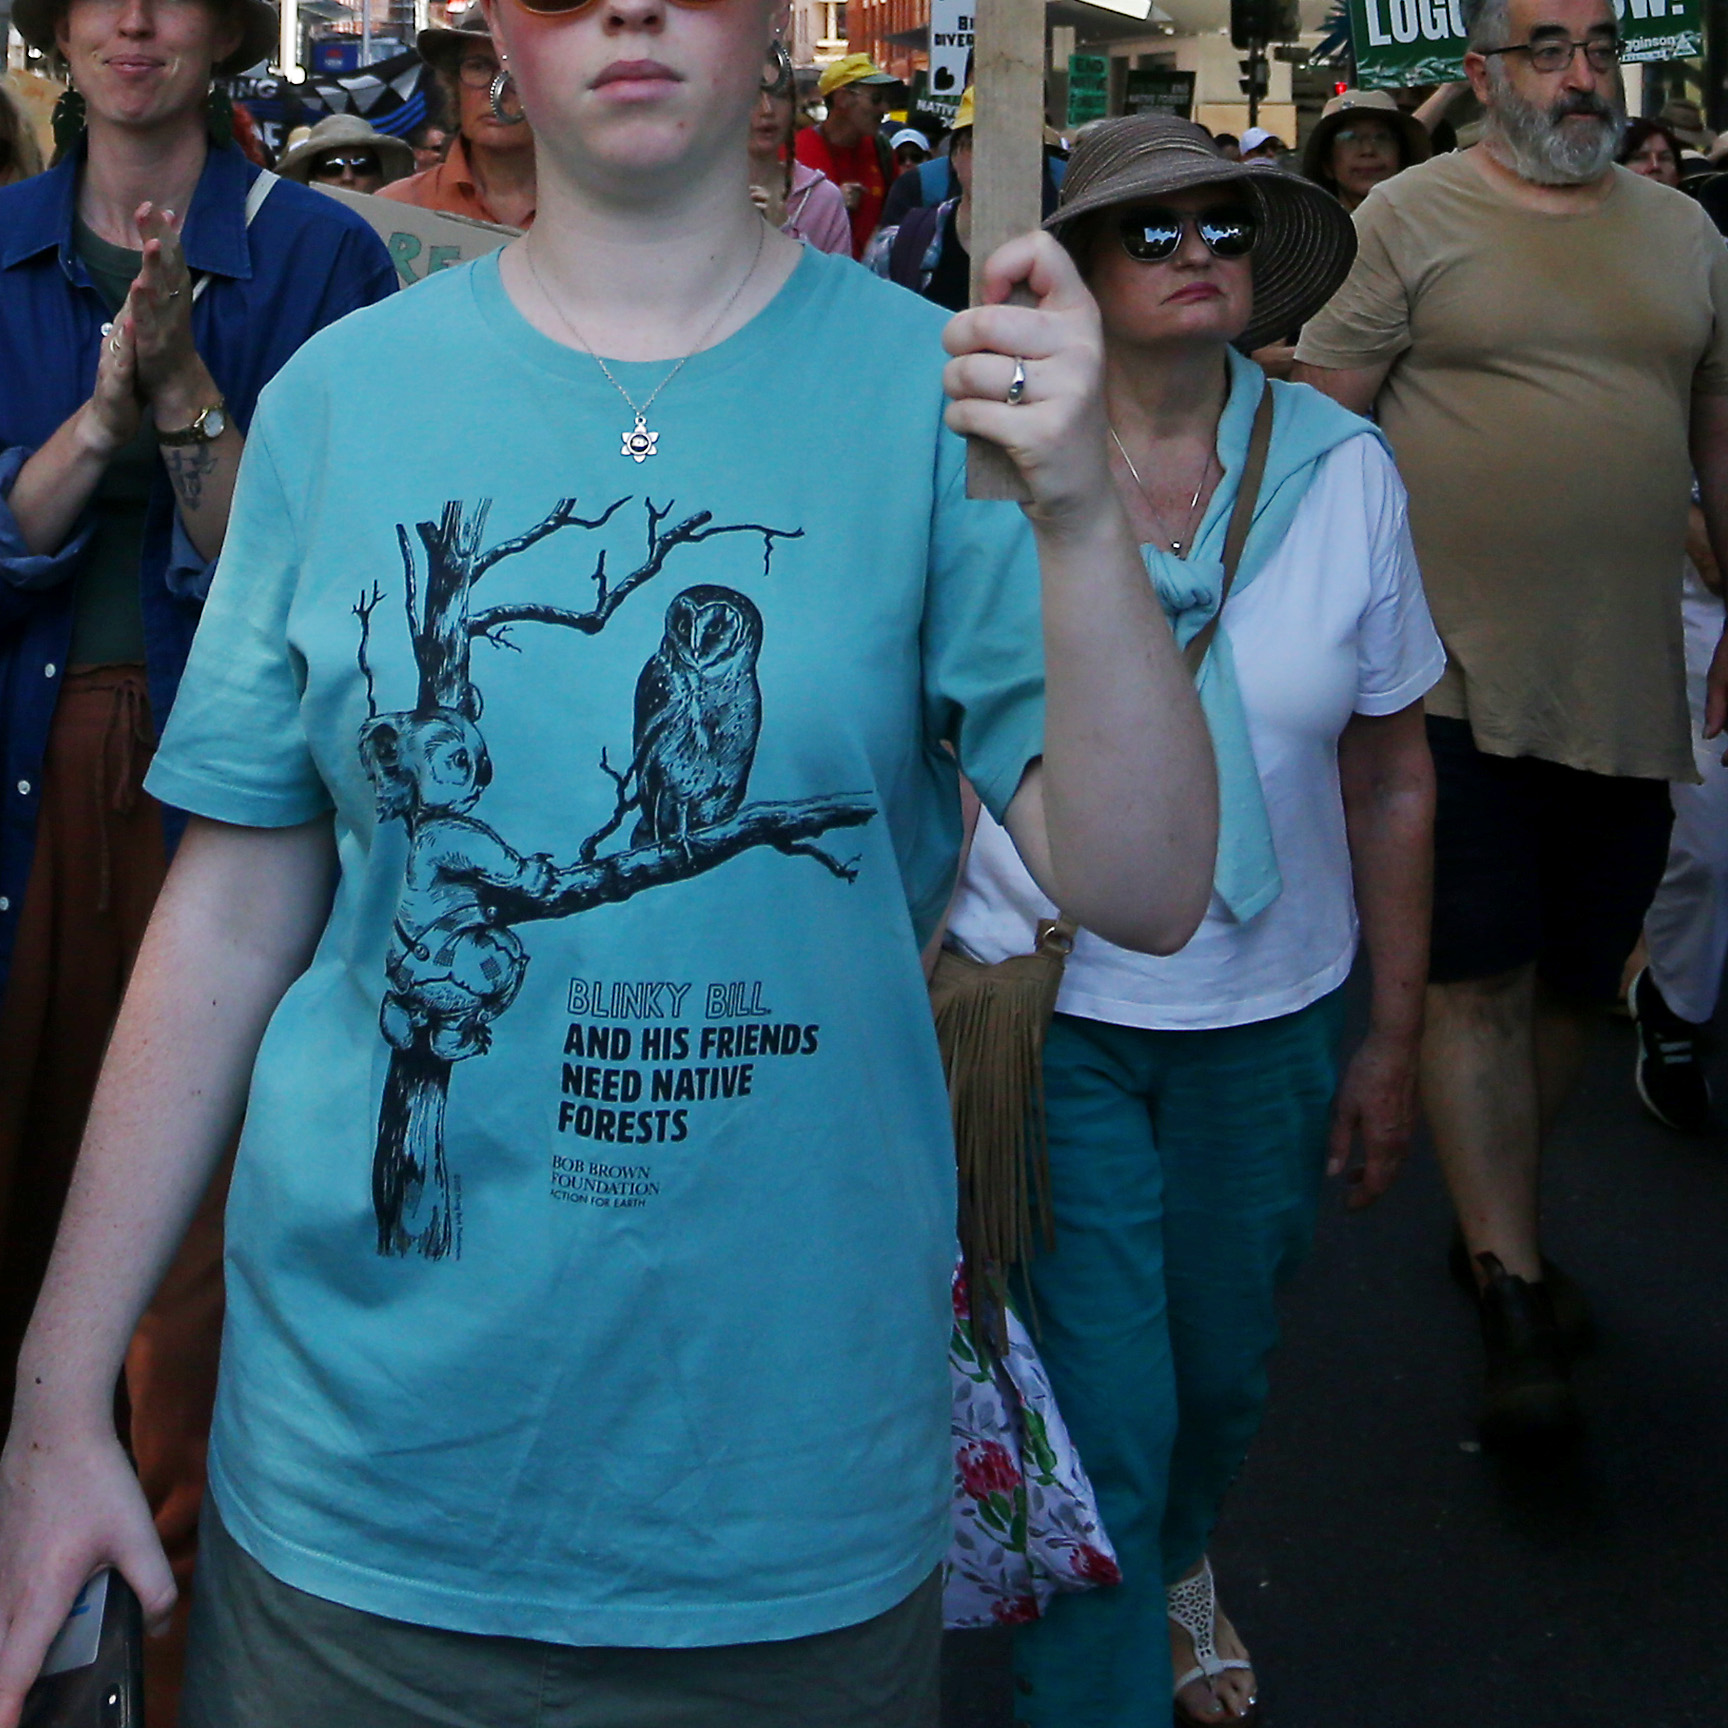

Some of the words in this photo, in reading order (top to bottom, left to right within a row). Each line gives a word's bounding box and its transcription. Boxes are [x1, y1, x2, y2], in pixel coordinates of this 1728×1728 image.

[567, 977, 692, 1020] BLINKY
[563, 1023, 632, 1061] AND
[641, 1027, 690, 1061] HIS
[699, 1023, 820, 1059] FRIENDS
[561, 1062, 642, 1103] NEED
[651, 1063, 754, 1103] NATIVE
[557, 1100, 688, 1144] FORESTS
[551, 1171, 661, 1196] FOUNDATION
[552, 1155, 584, 1173] BOB
[589, 1161, 651, 1180] BROWN
[591, 1195, 611, 1208] FOR
[614, 1197, 647, 1209] EARTH
